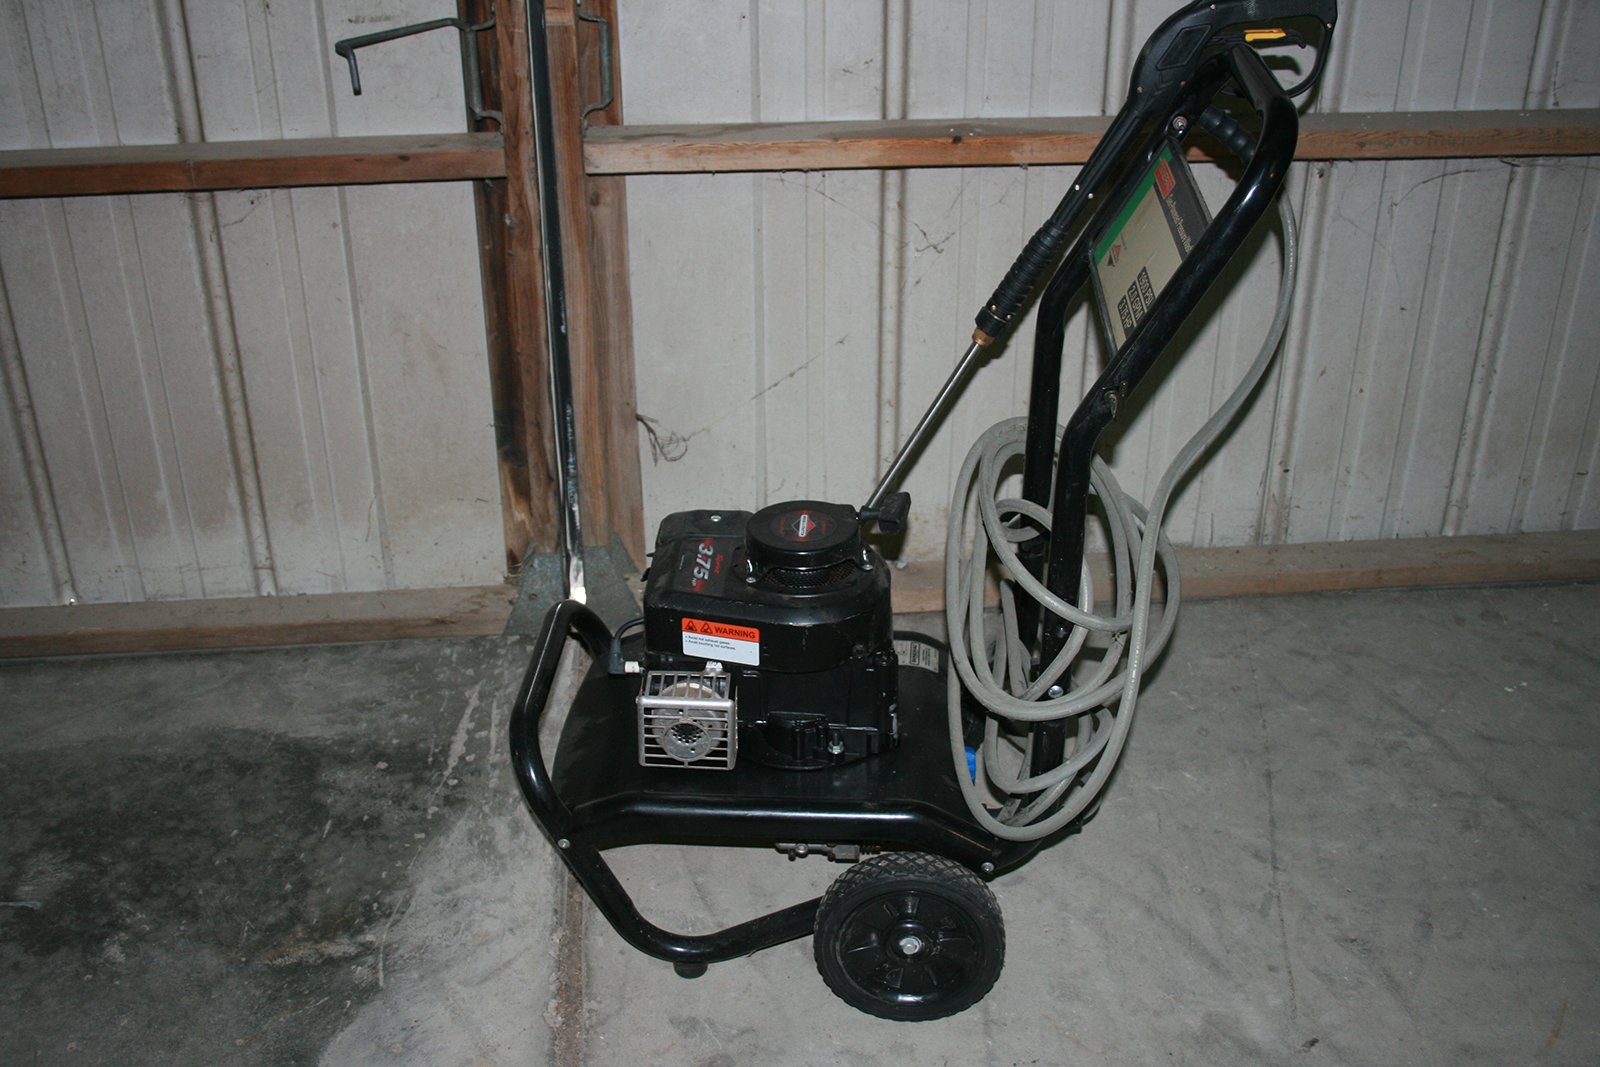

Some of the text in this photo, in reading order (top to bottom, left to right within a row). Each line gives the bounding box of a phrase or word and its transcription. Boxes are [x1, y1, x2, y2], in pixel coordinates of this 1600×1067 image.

[1145, 288, 1155, 307] PSI
[1132, 297, 1144, 321] GPM
[1123, 316, 1133, 329] HP
[693, 543, 713, 580] 3.75
[714, 626, 756, 639] WARNING
